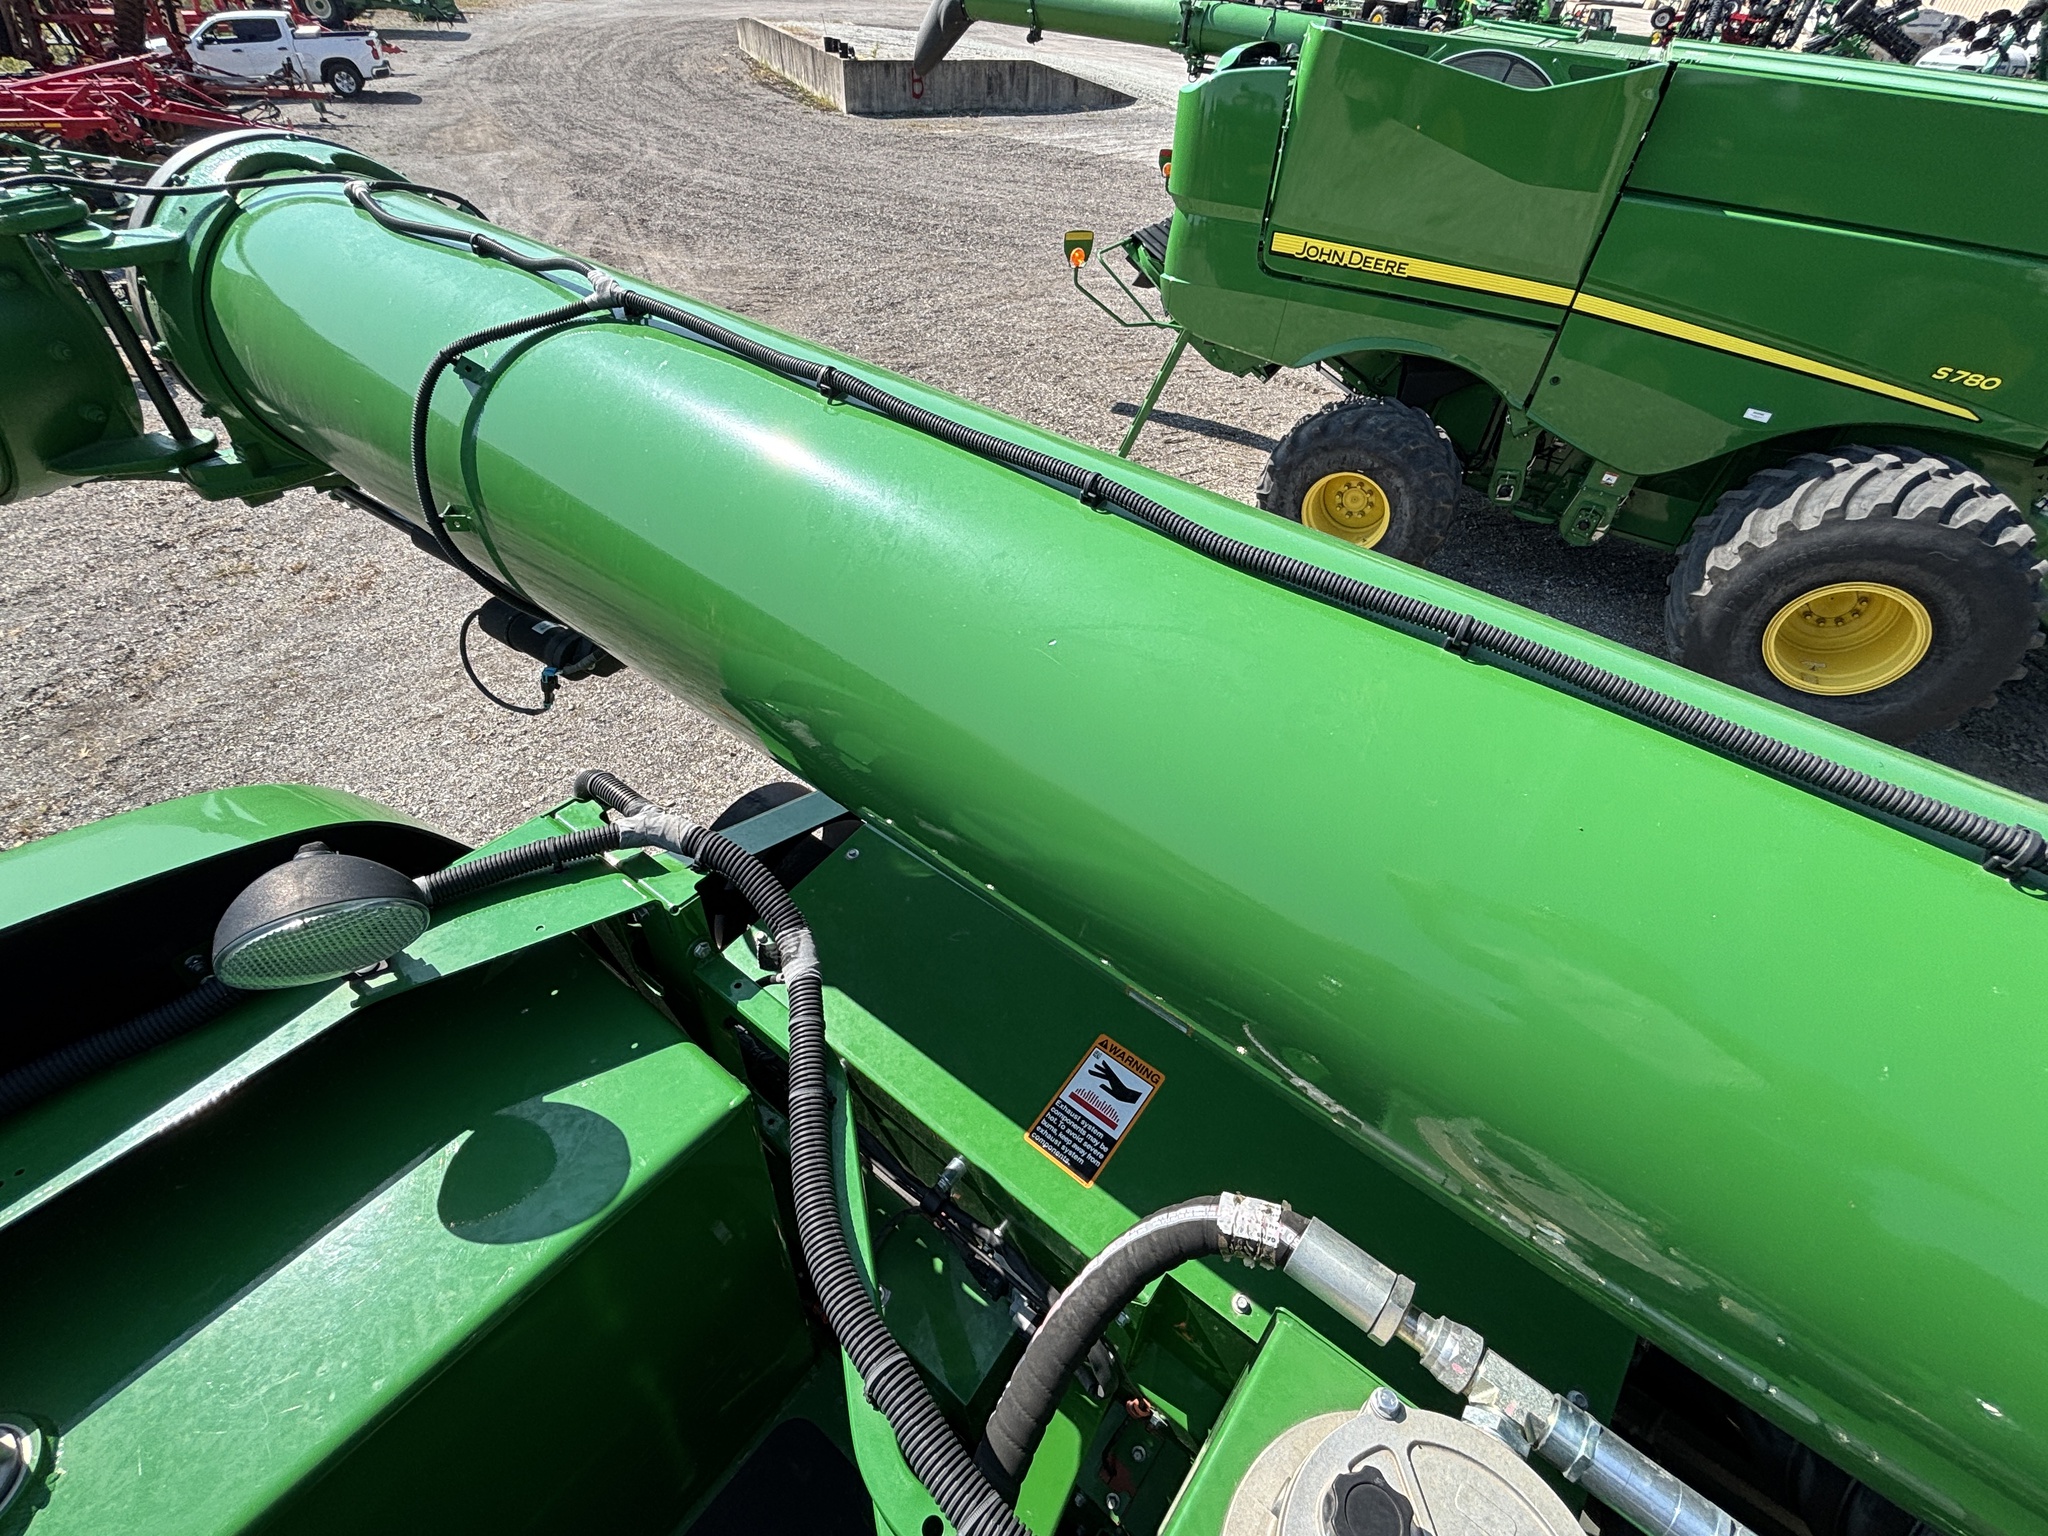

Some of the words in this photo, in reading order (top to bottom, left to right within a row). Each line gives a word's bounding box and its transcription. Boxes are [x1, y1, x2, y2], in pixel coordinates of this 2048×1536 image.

[1295, 241, 1345, 263] JOHN
[1349, 250, 1409, 275] DEERE
[1108, 1043, 1161, 1085] WARNING
[1045, 1112, 1058, 1125] hot.
[1058, 1121, 1066, 1130] To
[1065, 1128, 1082, 1143] avoid
[1082, 1141, 1104, 1160] severe
[1050, 1107, 1087, 1136] components
[1086, 1134, 1100, 1146] may
[1099, 1142, 1109, 1153] be
[1055, 1100, 1081, 1122] Exhaust
[1080, 1119, 1104, 1139] system
[1031, 1132, 1071, 1166] components.
[1036, 1126, 1061, 1147] exhaust
[1060, 1144, 1085, 1165] system
[1040, 1118, 1057, 1136] burns,
[1058, 1132, 1073, 1146] keep
[1071, 1142, 1087, 1157] away
[1086, 1152, 1101, 1167] from
